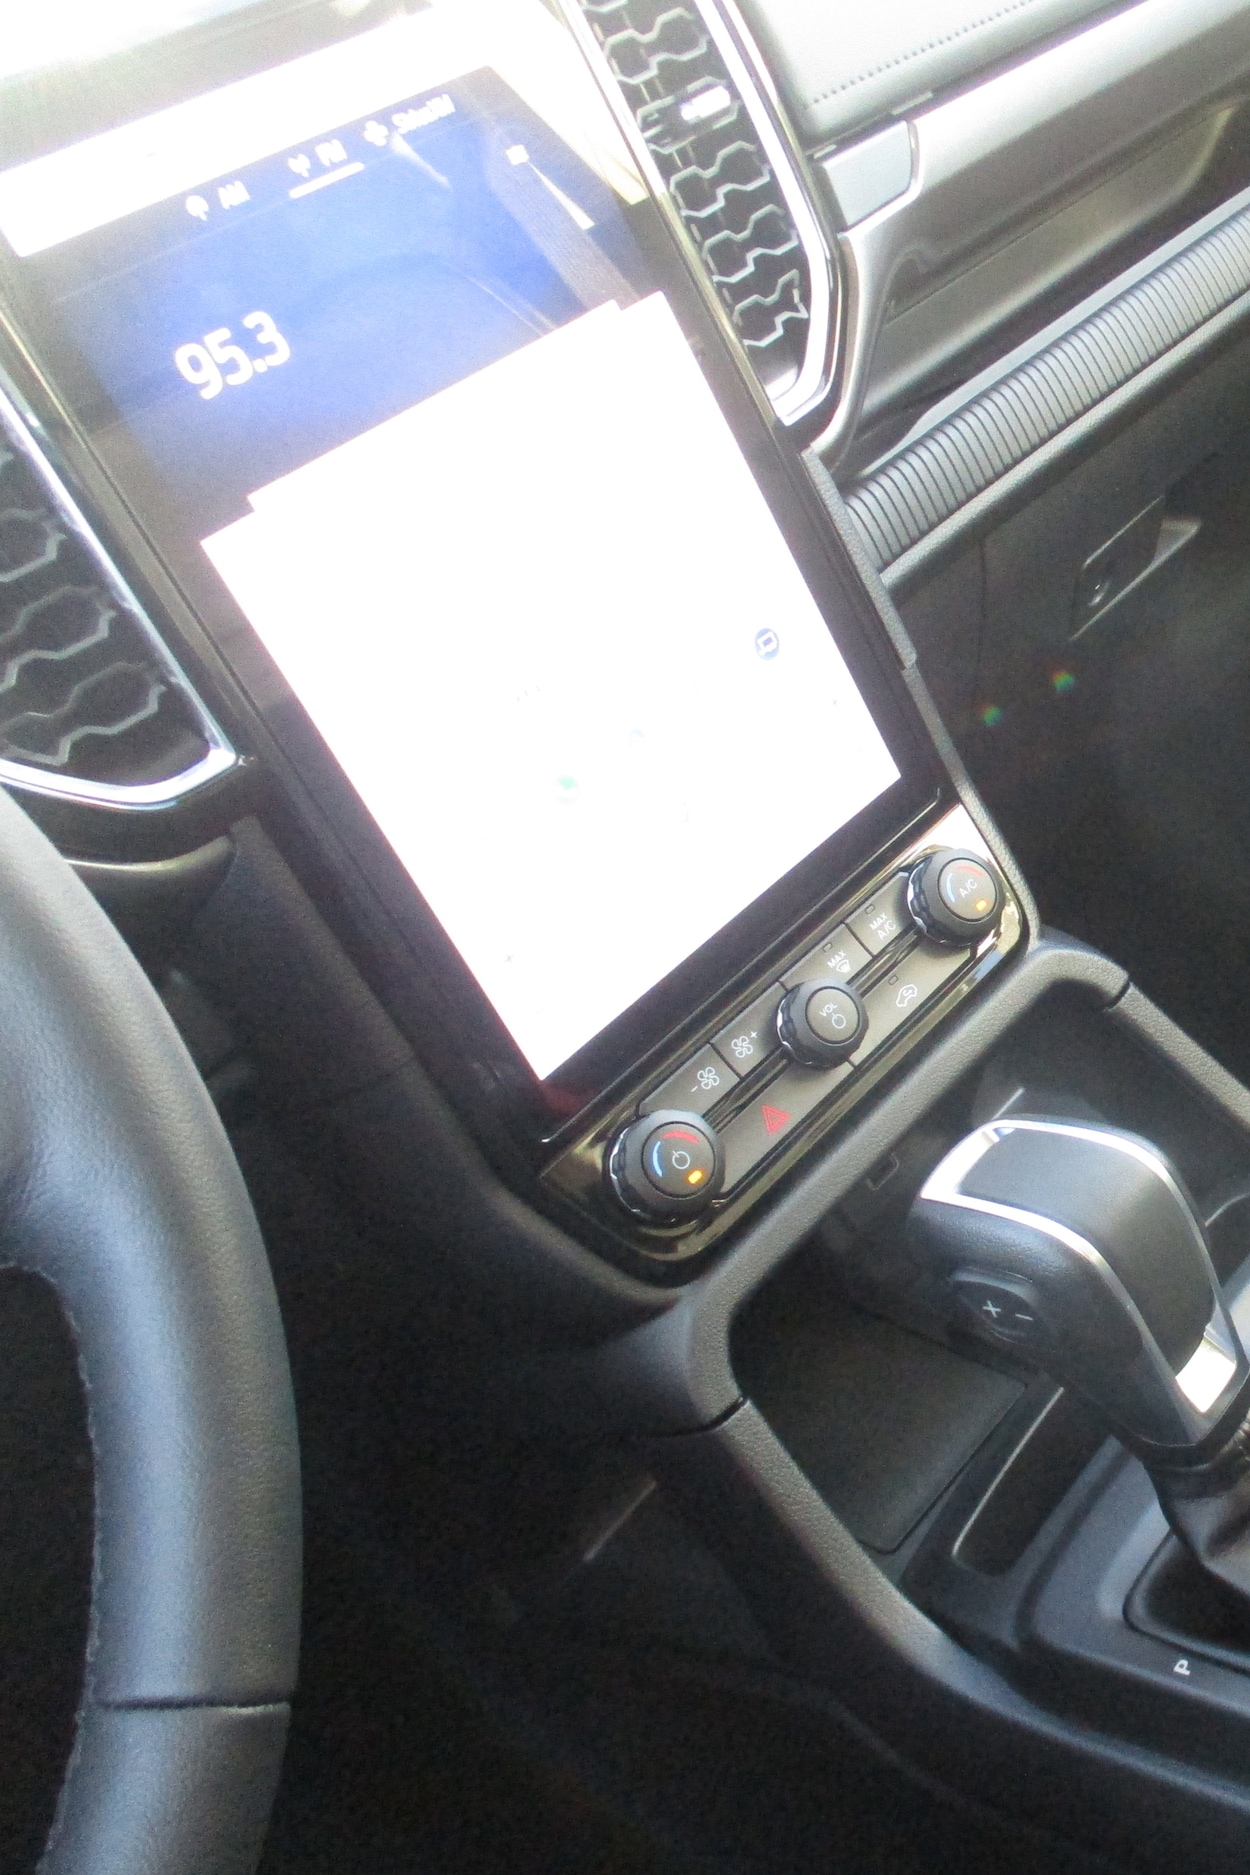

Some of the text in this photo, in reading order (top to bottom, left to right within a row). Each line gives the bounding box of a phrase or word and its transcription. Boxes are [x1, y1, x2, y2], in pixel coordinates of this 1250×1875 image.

[174, 310, 291, 400] 95.3
[959, 878, 978, 898] A/C
[869, 912, 889, 931] MAX
[877, 920, 896, 940] A/C
[827, 950, 847, 969] MAX
[818, 1002, 838, 1018] VOL
[1173, 1659, 1191, 1676] P
